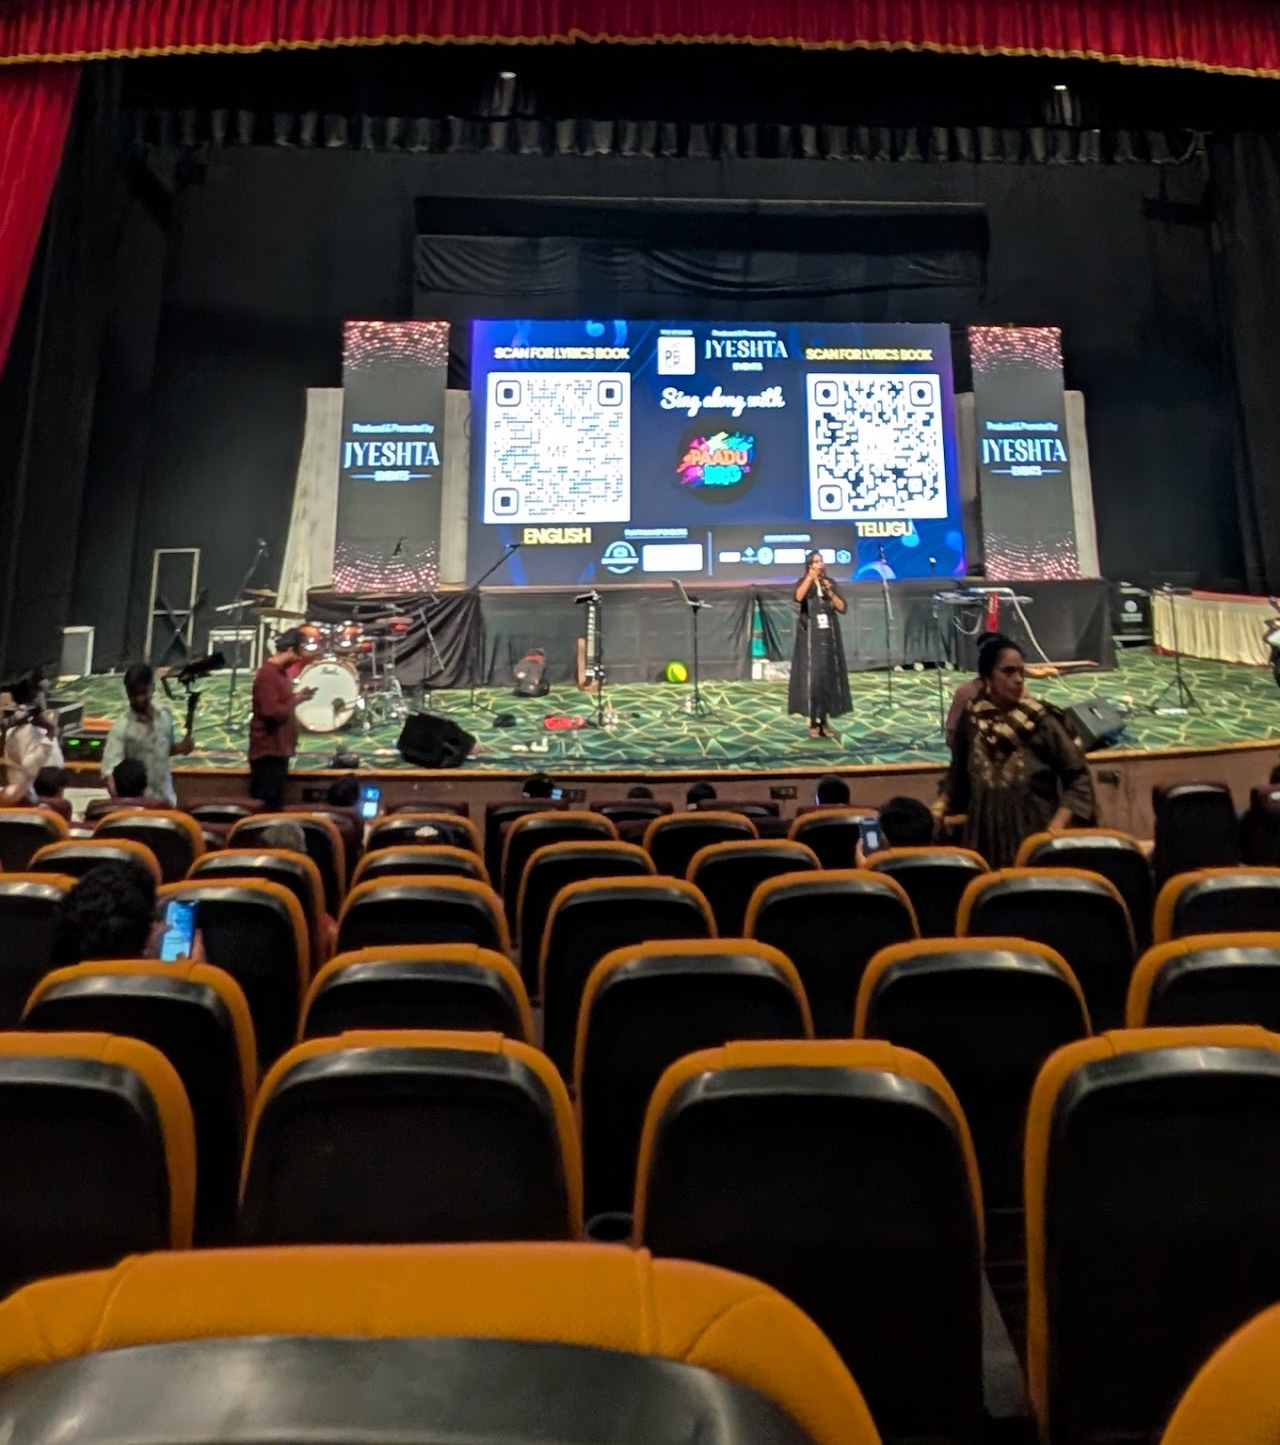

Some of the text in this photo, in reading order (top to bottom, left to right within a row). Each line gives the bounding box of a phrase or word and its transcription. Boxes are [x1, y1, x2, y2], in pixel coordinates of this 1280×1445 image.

[494, 347, 630, 359] SCAN FOR LYRICS BOOK
[704, 340, 788, 359] JYESHTA
[805, 348, 933, 361] SCAN FOR LYRICS BOOK
[660, 386, 786, 417] Sing along with
[344, 442, 440, 468] JYESHTA
[982, 439, 1067, 464] JYESHTA
[523, 528, 591, 544] ENGLISH
[855, 522, 912, 537] TELUGU
